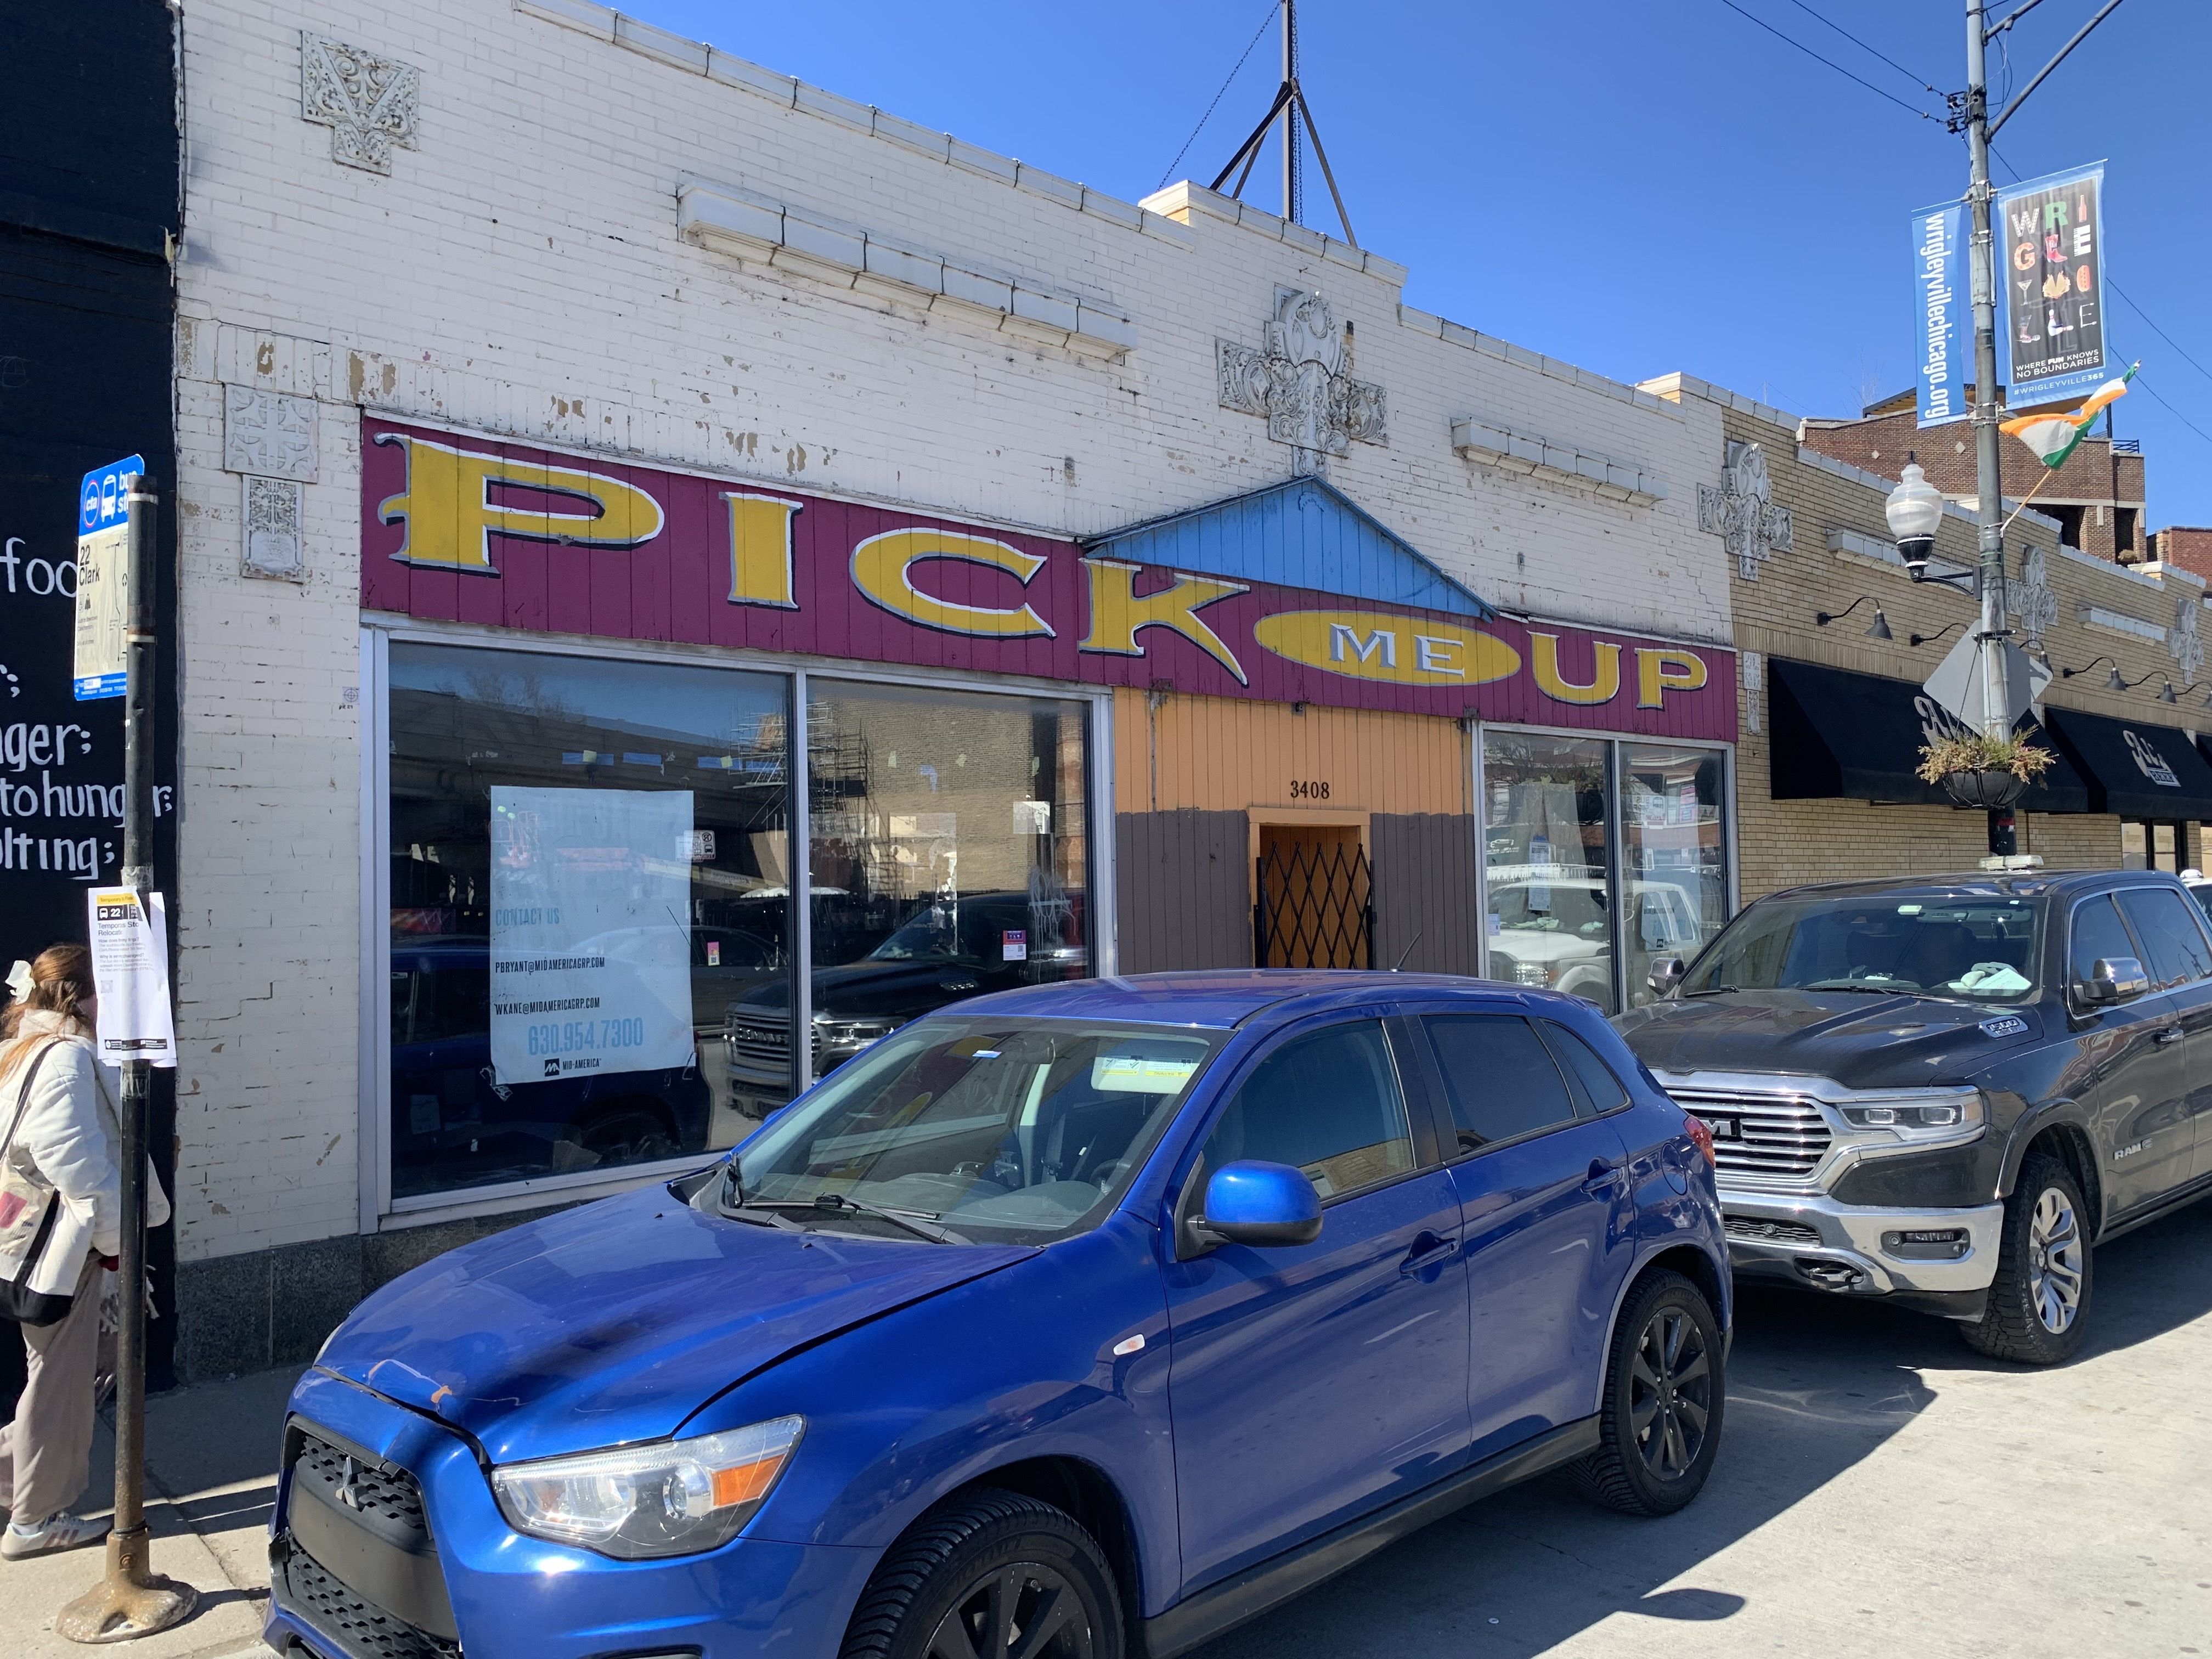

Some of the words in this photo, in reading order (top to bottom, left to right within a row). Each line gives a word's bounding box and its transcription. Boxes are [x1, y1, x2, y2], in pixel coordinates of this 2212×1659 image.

[1920, 212, 1953, 420] wrigleyvillechicago.org
[2016, 360, 2046, 371] WHERE
[2047, 357, 2064, 365] FUN
[2067, 349, 2099, 361] KNOWS
[2016, 370, 2031, 379] NO
[2034, 356, 2100, 376] BOUNDARIES
[2014, 372, 2104, 396] #WRIGLEYVILLE365
[119, 470, 138, 491] bu
[86, 495, 98, 512] cta
[80, 544, 91, 566] 22
[0, 537, 77, 598] foo
[79, 563, 100, 586] Clark
[374, 432, 1250, 688] PICK
[1329, 623, 1465, 678] ME
[1527, 629, 1708, 711] UP
[0, 723, 92, 772] ger;
[42, 770, 173, 828] hungr;
[1290, 780, 1330, 799] 3408
[0, 827, 115, 880] lting;
[110, 907, 121, 918] 22
[495, 907, 543, 926] CONTACT
[546, 907, 560, 924] US
[495, 956, 605, 973] PBRYANT@MIDAMERICAGRP.COM
[495, 997, 600, 1015] WKANE@MIDAMERICAGRP.COM
[1987, 1019, 2020, 1031] 1500
[528, 1017, 644, 1056] 630.954.7300
[562, 1058, 600, 1070] MID-AMERICA
[2113, 1142, 2142, 1161] RAM
